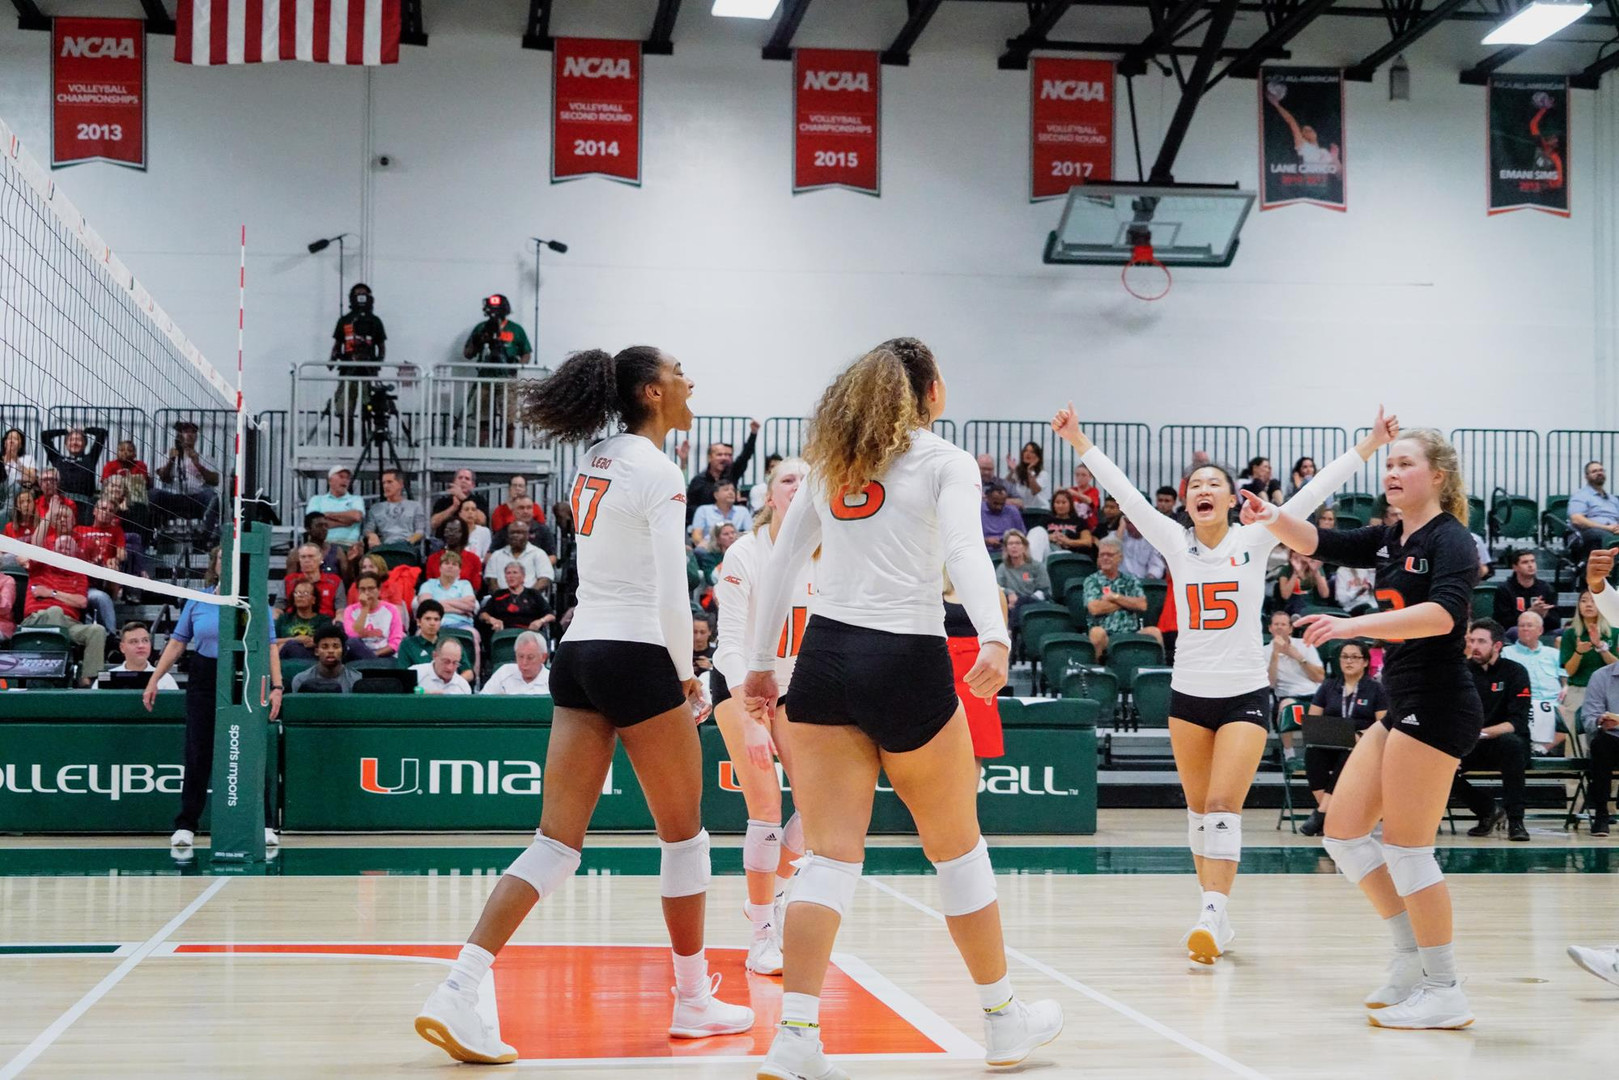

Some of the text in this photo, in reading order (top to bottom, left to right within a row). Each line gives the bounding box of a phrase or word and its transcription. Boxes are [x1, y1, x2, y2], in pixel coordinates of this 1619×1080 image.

[61, 36, 135, 59] NCAA
[563, 57, 631, 79] NCAA
[68, 84, 127, 94] VOLLEYBALL
[803, 71, 869, 92] NCAA
[57, 94, 139, 105] CHAMPIONSHIPS
[1041, 80, 1105, 102] NCAA
[569, 103, 624, 113] VOLLEYBALL
[560, 112, 633, 122] SECOND ROUND
[809, 115, 862, 125] VOLLEYBALL
[77, 124, 122, 141] 2013
[574, 140, 619, 157] 2014
[814, 151, 858, 168] 2015
[1051, 162, 1093, 178] 2017
[1270, 163, 1298, 174] LANE
[571, 473, 612, 537] 17
[1405, 556, 1428, 574] U
[1186, 580, 1239, 630] 15
[227, 725, 240, 807] sports imports
[360, 757, 419, 795] U
